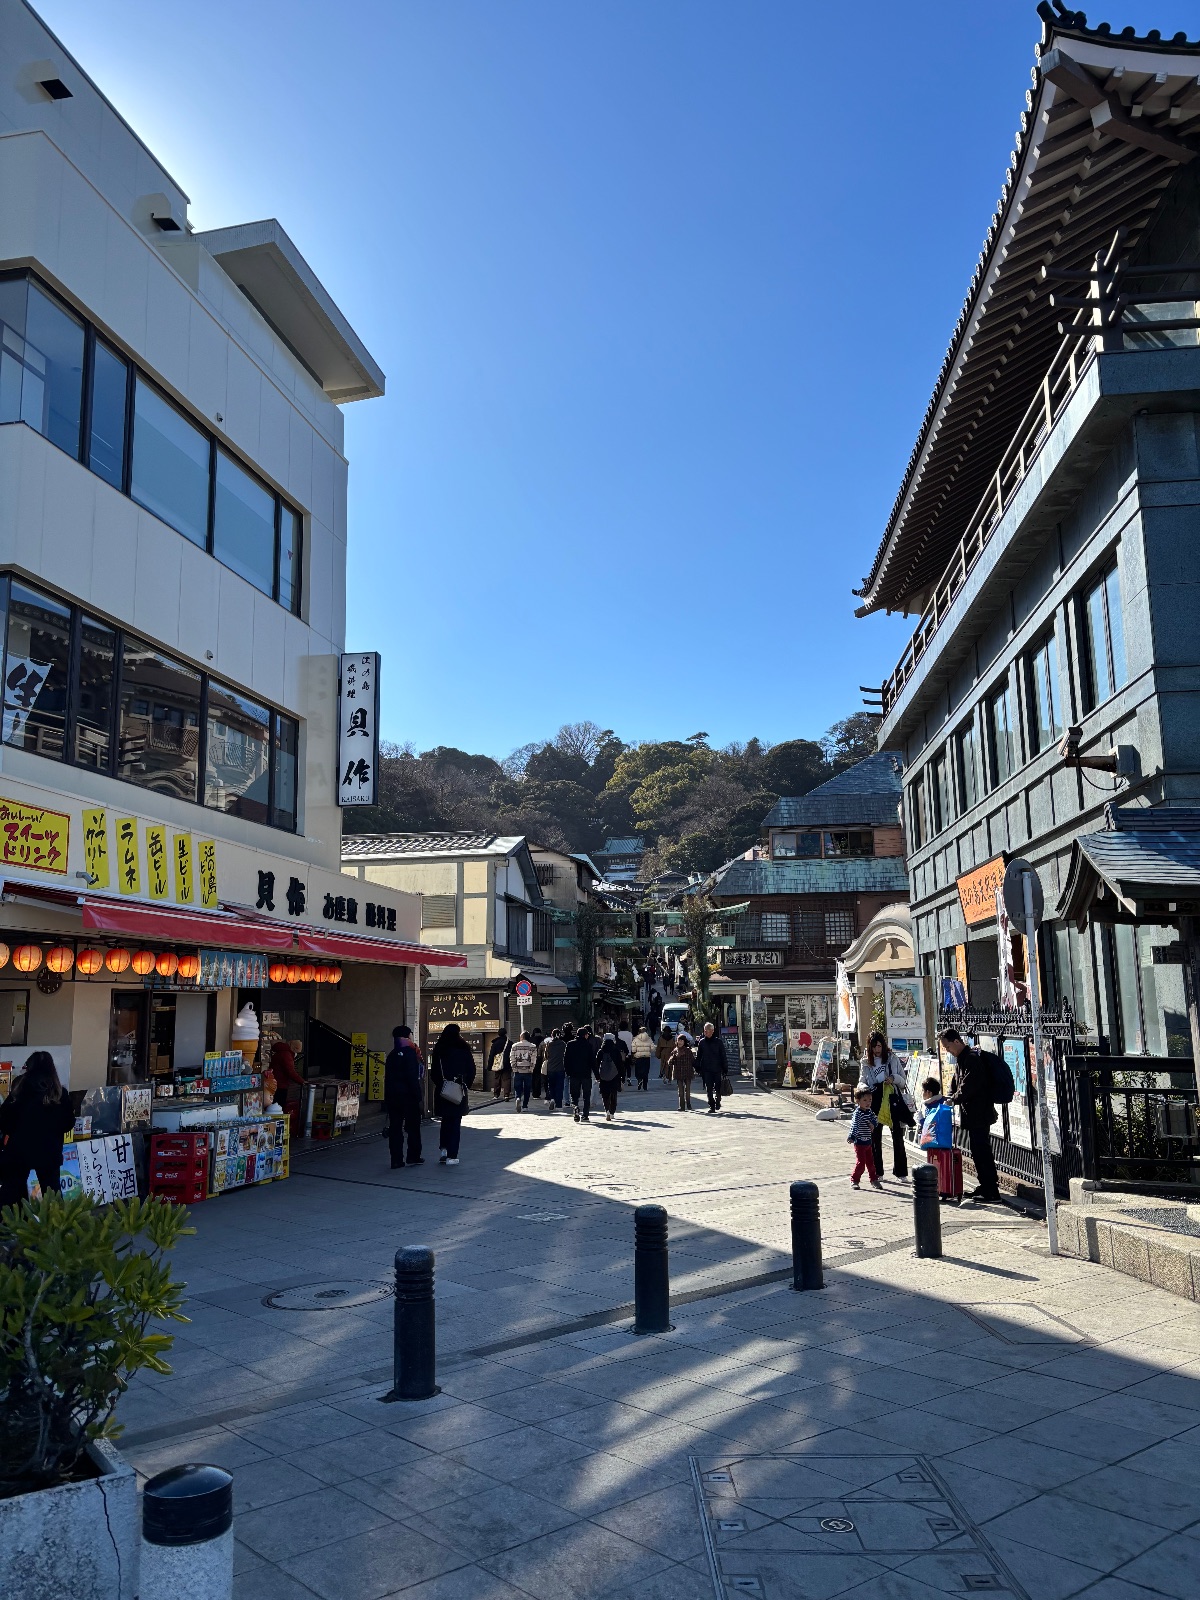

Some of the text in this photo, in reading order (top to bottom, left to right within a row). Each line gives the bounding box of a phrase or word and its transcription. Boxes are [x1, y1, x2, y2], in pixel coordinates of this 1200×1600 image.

[342, 707, 371, 789] 貝作
[341, 795, 370, 803] KAISAKU
[4, 822, 60, 847] スイーツ
[4, 841, 61, 866] ドリンク
[121, 823, 137, 890] ラムネ
[149, 831, 167, 895] 缶ビール
[178, 839, 191, 900] 生ビール
[112, 1135, 136, 1196] 甘酒
